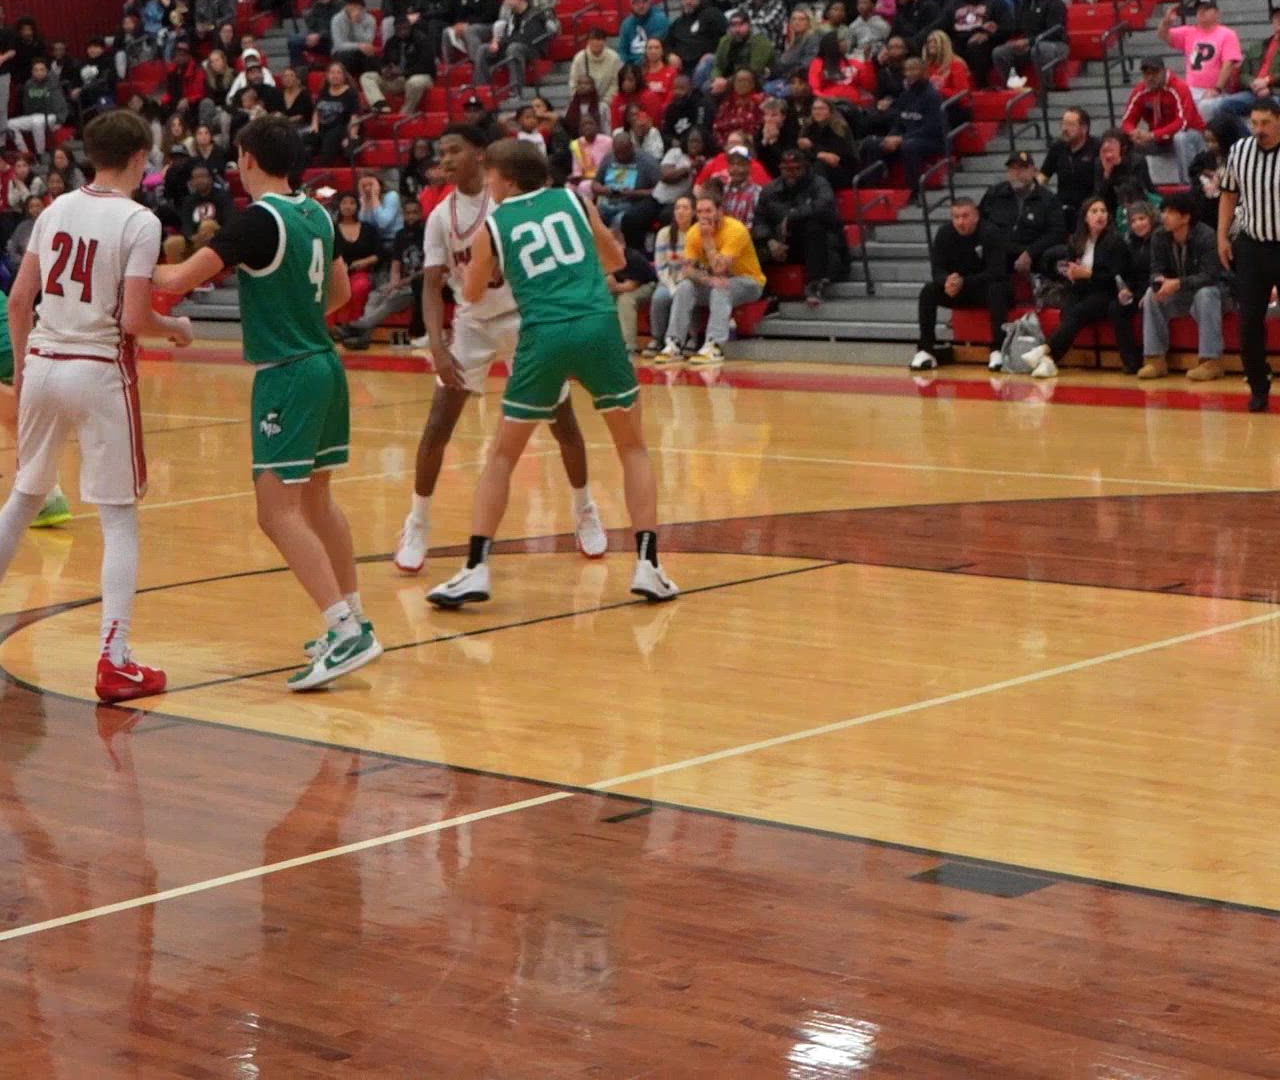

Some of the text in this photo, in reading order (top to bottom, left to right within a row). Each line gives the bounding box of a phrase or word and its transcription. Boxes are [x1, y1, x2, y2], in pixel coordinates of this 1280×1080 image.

[1189, 42, 1216, 74] P
[44, 231, 99, 304] 24
[307, 237, 326, 303] 4
[510, 210, 587, 280] 20
